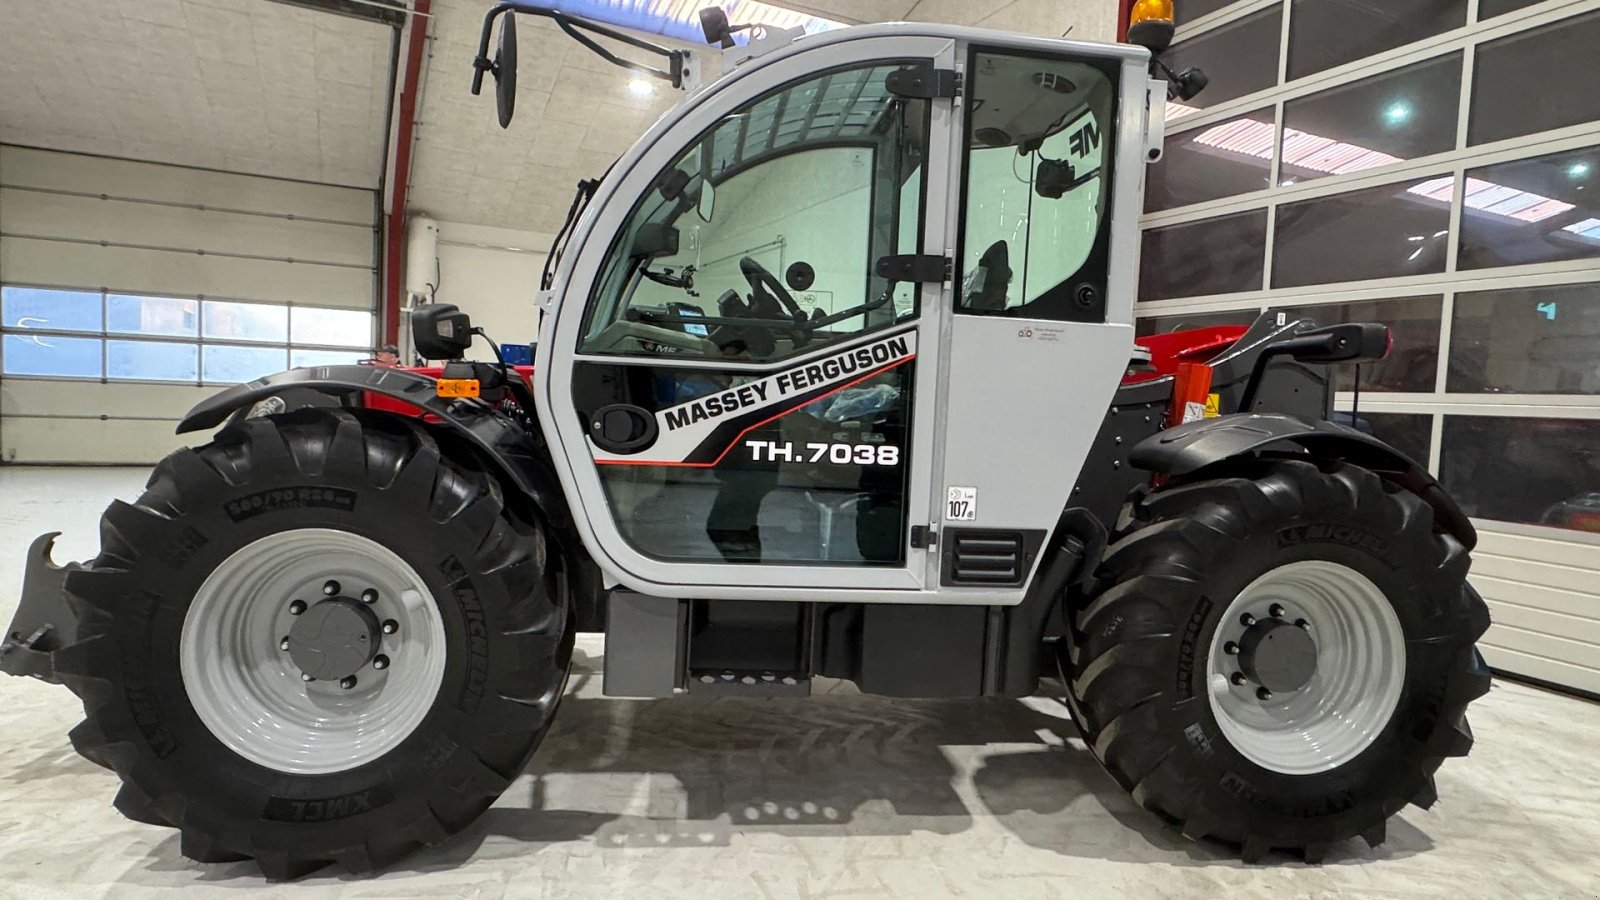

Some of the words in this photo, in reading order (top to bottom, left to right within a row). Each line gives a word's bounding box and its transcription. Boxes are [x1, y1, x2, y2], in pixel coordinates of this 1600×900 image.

[664, 381, 768, 431] MASSEY
[776, 337, 908, 395] FERGUSON
[745, 440, 899, 465] TH.7038
[948, 500, 969, 518] 107
